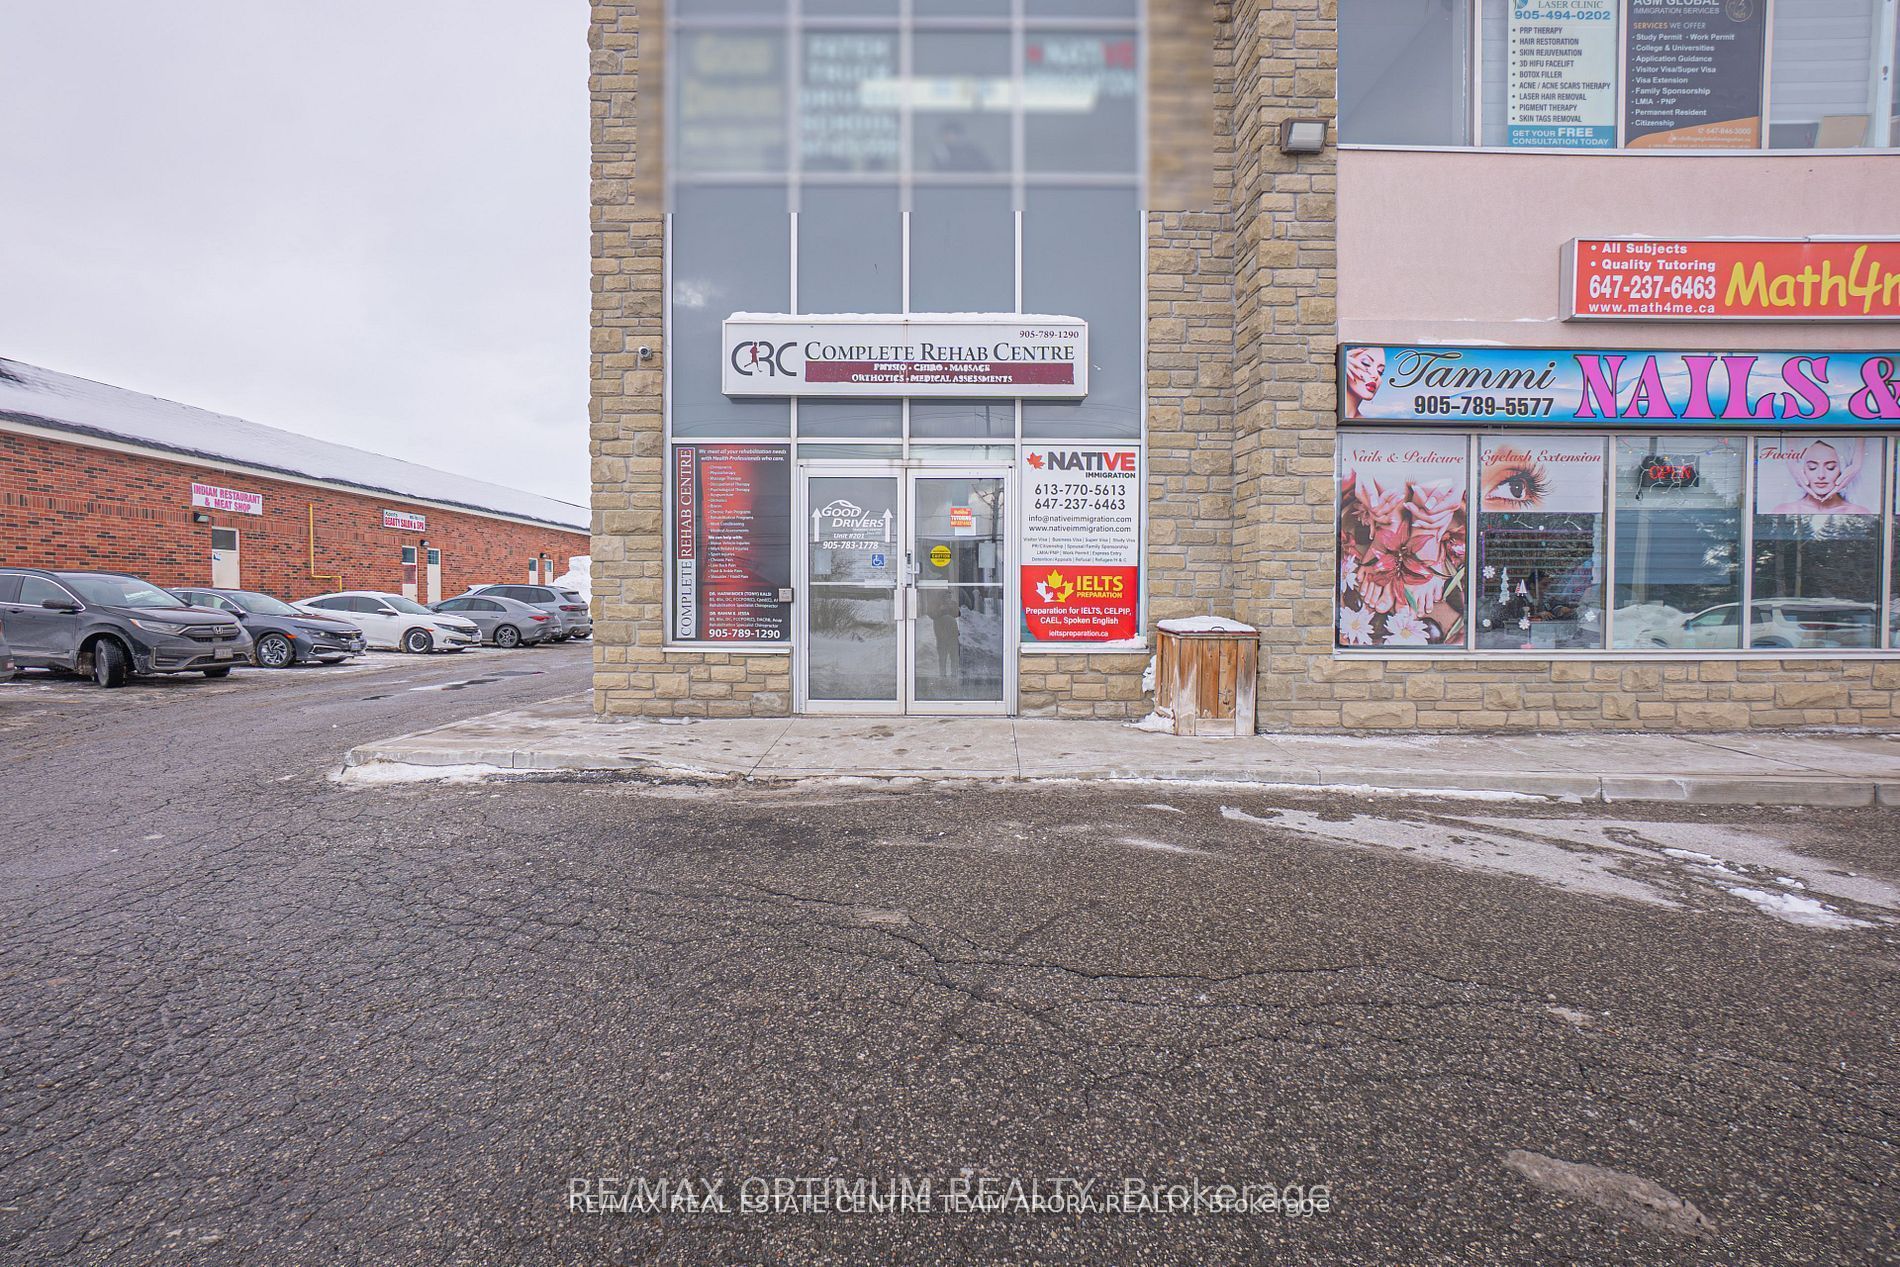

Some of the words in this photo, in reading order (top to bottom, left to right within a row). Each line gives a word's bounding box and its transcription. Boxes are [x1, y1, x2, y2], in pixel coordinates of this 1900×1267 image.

[1538, 0, 1568, 9] LASER
[1570, 0, 1603, 9] CLINIC
[1515, 10, 1611, 20] 905-494-0202
[1536, 38, 1579, 46] RESTORATION
[1536, 49, 1582, 57] REJUVENATION
[1636, 55, 1676, 63] Application
[1660, 66, 1698, 74] Visa/Super
[1542, 82, 1558, 90] ACNE
[1560, 82, 1580, 90] SCARS
[1582, 82, 1611, 90] THERAPY
[1557, 93, 1587, 101] REMOVAL
[1549, 104, 1577, 112] THERAPY
[1558, 127, 1594, 137] FREE
[1579, 138, 1609, 146] TODAY
[1602, 243, 1621, 254] All
[1626, 243, 1688, 256] Subjects
[1601, 259, 1652, 272] Quality
[1657, 259, 1716, 273] Tutoring
[1589, 275, 1717, 300] 647-237-6463
[1589, 302, 1715, 314] www.math4me.ca
[1019, 329, 1080, 339] 905-789-1290
[804, 341, 914, 361] COMPLETE
[920, 341, 988, 361] REHAB
[993, 342, 1075, 361] CENTRE
[914, 364, 943, 372] CHIRO
[949, 364, 991, 372] MASSAGE
[1389, 349, 1557, 390] Tammi
[851, 374, 905, 383] ORTHOTICS
[910, 374, 951, 383] MEDICAL
[952, 374, 1013, 383] ASSESSMENTS
[1573, 354, 1831, 420] NAILS
[1847, 355, 1900, 420] &
[1413, 395, 1554, 417] 905-789-5577
[1344, 450, 1382, 463] Nails
[1387, 451, 1399, 463] &
[1402, 450, 1464, 464] Pedicure
[1480, 450, 1532, 466] Eyelash
[1537, 450, 1601, 463] Extension
[1759, 447, 1807, 462] Facial
[1047, 451, 1136, 472] NATIVE
[681, 449, 692, 505] CENTRE
[1649, 465, 1693, 479] OPEN
[193, 484, 218, 498] INDIAN
[219, 489, 261, 505] RESTAURANT
[1034, 484, 1126, 496] 613-770-5613
[204, 497, 210, 507] &
[214, 498, 232, 510] MEAT
[234, 501, 251, 512] SHOP
[1034, 498, 1126, 511] 647-237-6463
[821, 507, 861, 517] GOOD
[831, 511, 884, 528] DRIVERS
[1028, 514, 1132, 525] info@nativeimmigration.com
[681, 508, 692, 557] REHAB
[1028, 526, 1131, 535] www.nativeimmigration.com
[823, 541, 879, 550] 905-783-1778
[1076, 575, 1124, 591] IELTS
[681, 561, 692, 636] COMPLETE
[1025, 606, 1068, 617] Preparation
[1069, 606, 1079, 616] for
[1080, 607, 1102, 616] IELTS,
[1103, 607, 1132, 617] CELPIP,
[1040, 616, 1061, 625] CAEL,
[1063, 616, 1091, 626] Spoken
[1092, 617, 1119, 626] English
[708, 628, 781, 639] 905-789-1290
[1048, 629, 1109, 639] ieltspreparation.ca
